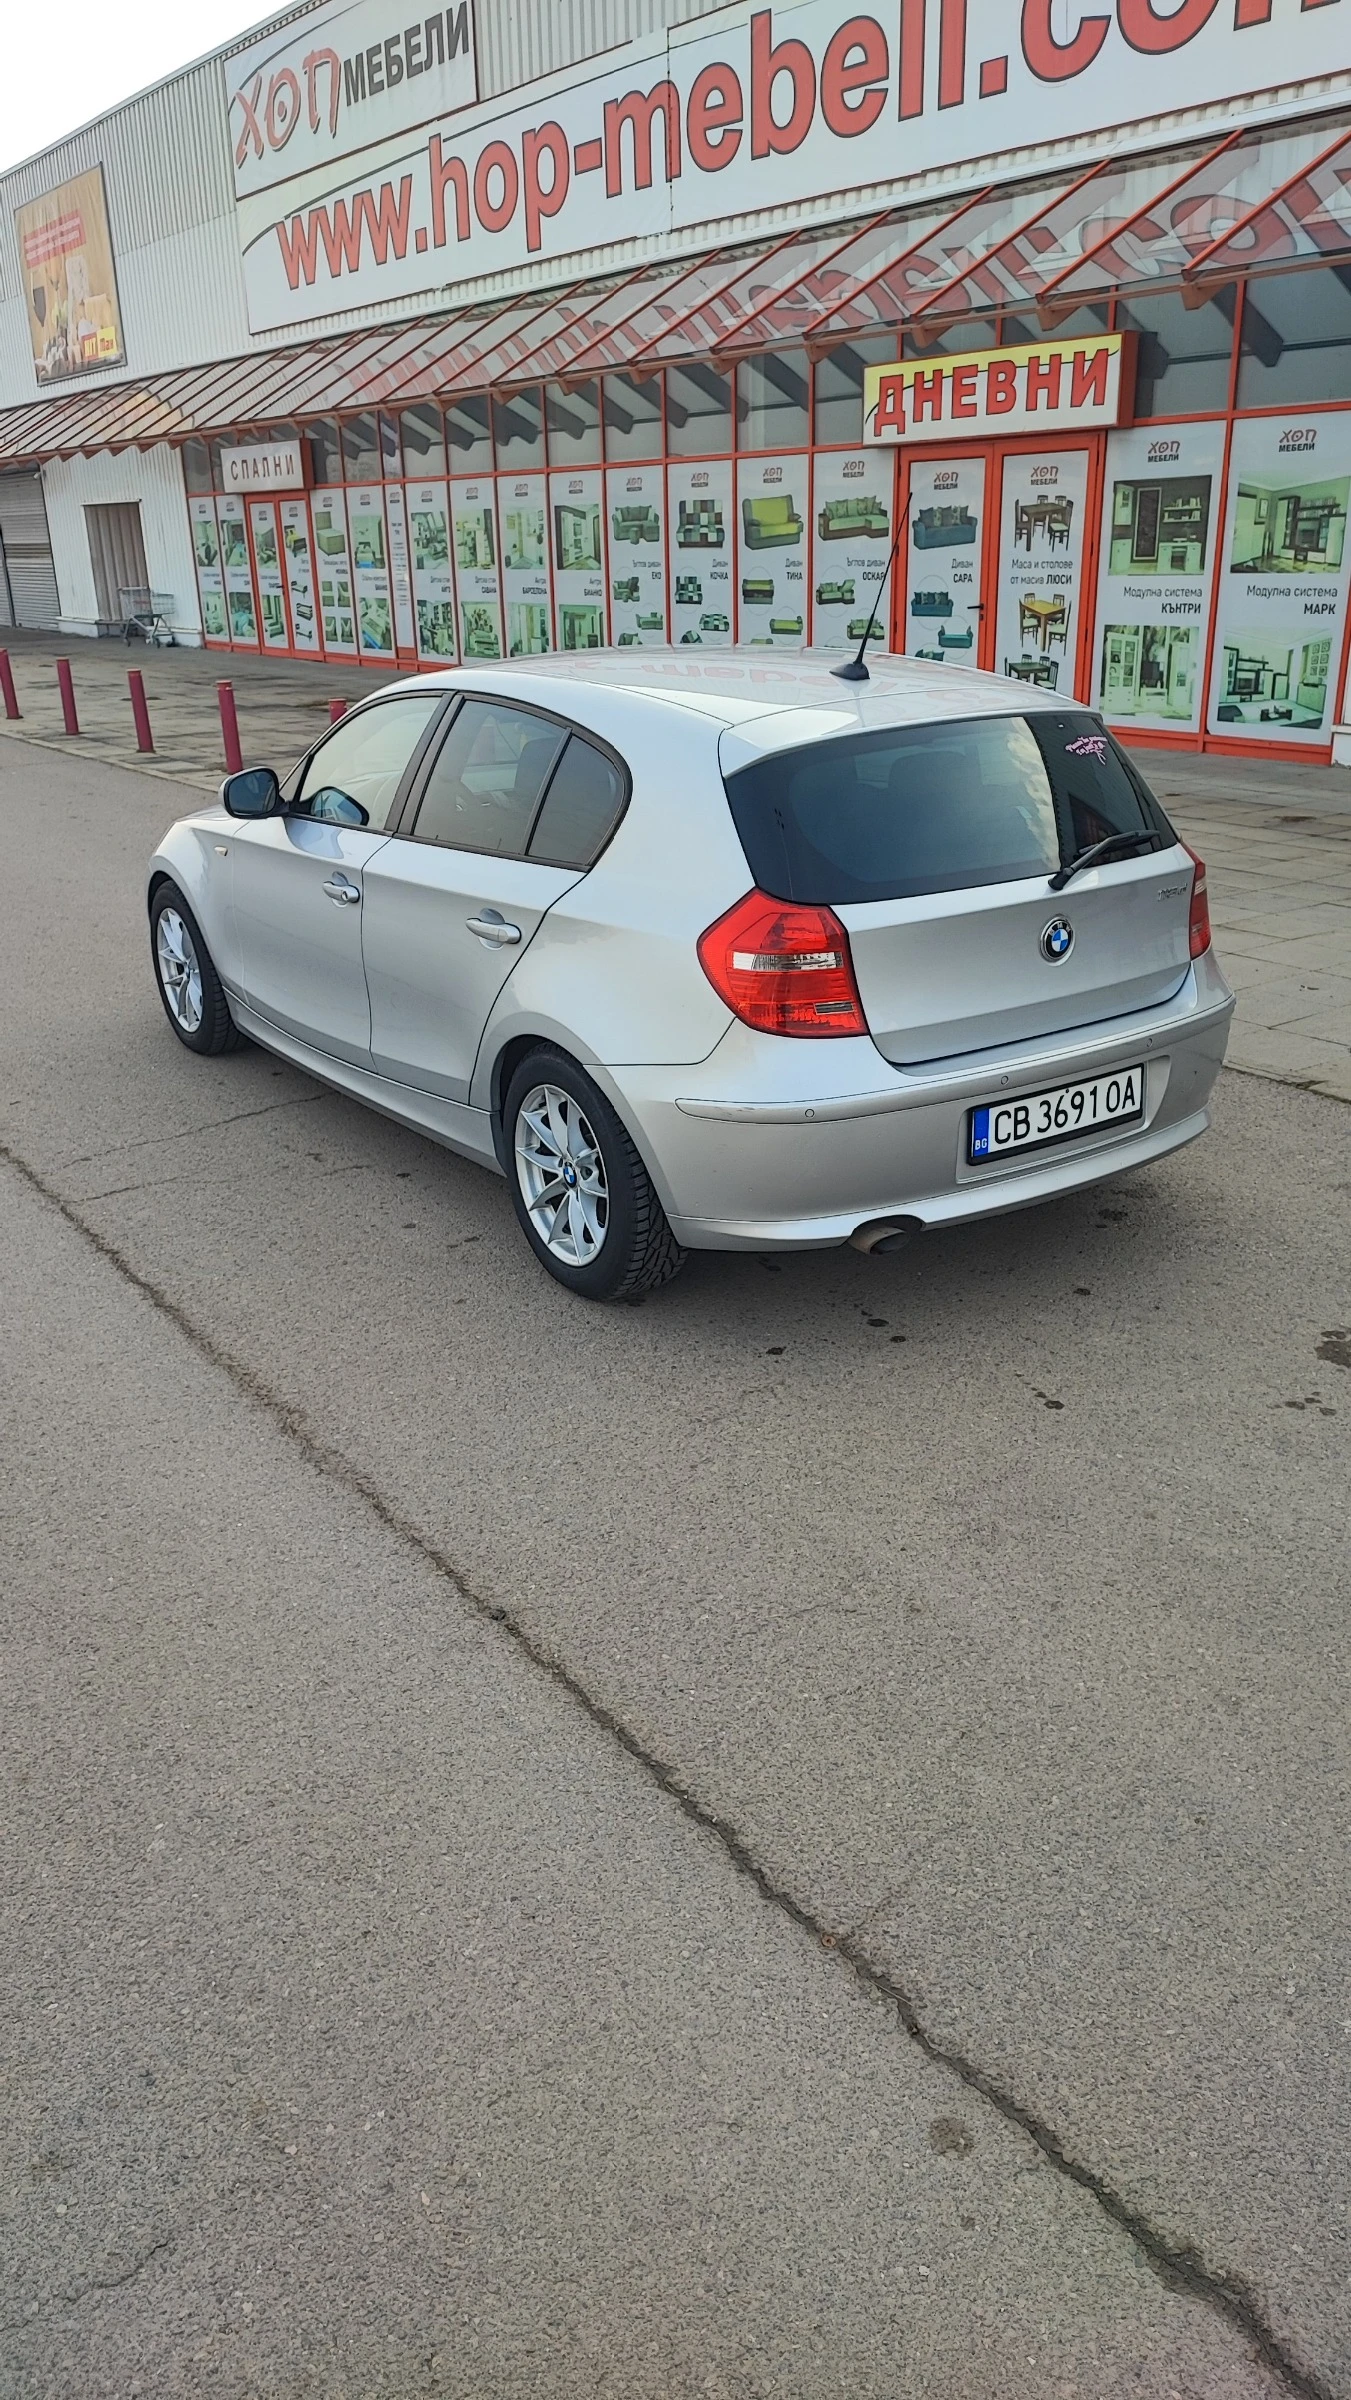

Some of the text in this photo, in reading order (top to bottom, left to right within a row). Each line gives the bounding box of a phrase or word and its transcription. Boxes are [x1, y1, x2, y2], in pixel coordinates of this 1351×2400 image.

[235, 1, 469, 169] ХОП МЕБЕЛИ
[276, 0, 1341, 290] www.hop-mebeli.c
[873, 347, 1110, 437] ДНЕВНИ
[1279, 428, 1317, 443] ХОП
[1148, 440, 1181, 454] ХОП
[1278, 442, 1315, 452] МЕБЕЛИ
[1147, 453, 1179, 463] МЕБЕЛИ
[230, 454, 295, 481] СПАЛНИ
[1031, 466, 1059, 478] ХОП
[934, 471, 959, 483] ХОП
[1030, 478, 1058, 486] МЕБЕЛИ
[951, 558, 974, 569] Диван
[1012, 559, 1073, 569] Маса и столове
[786, 571, 803, 580] ТИНА
[862, 571, 886, 580] ОСКАР
[953, 573, 973, 583] САРА
[1010, 574, 1072, 585] от масив ЛЮСИ
[1123, 586, 1203, 600] Модулна система
[1246, 585, 1338, 600] Модулна система
[1161, 602, 1201, 614] КЪНТРИ
[1303, 603, 1336, 615] МАРК
[994, 1105, 1031, 1145] CB
[1037, 1085, 1098, 1134] 3691
[974, 1137, 988, 1151] BG
